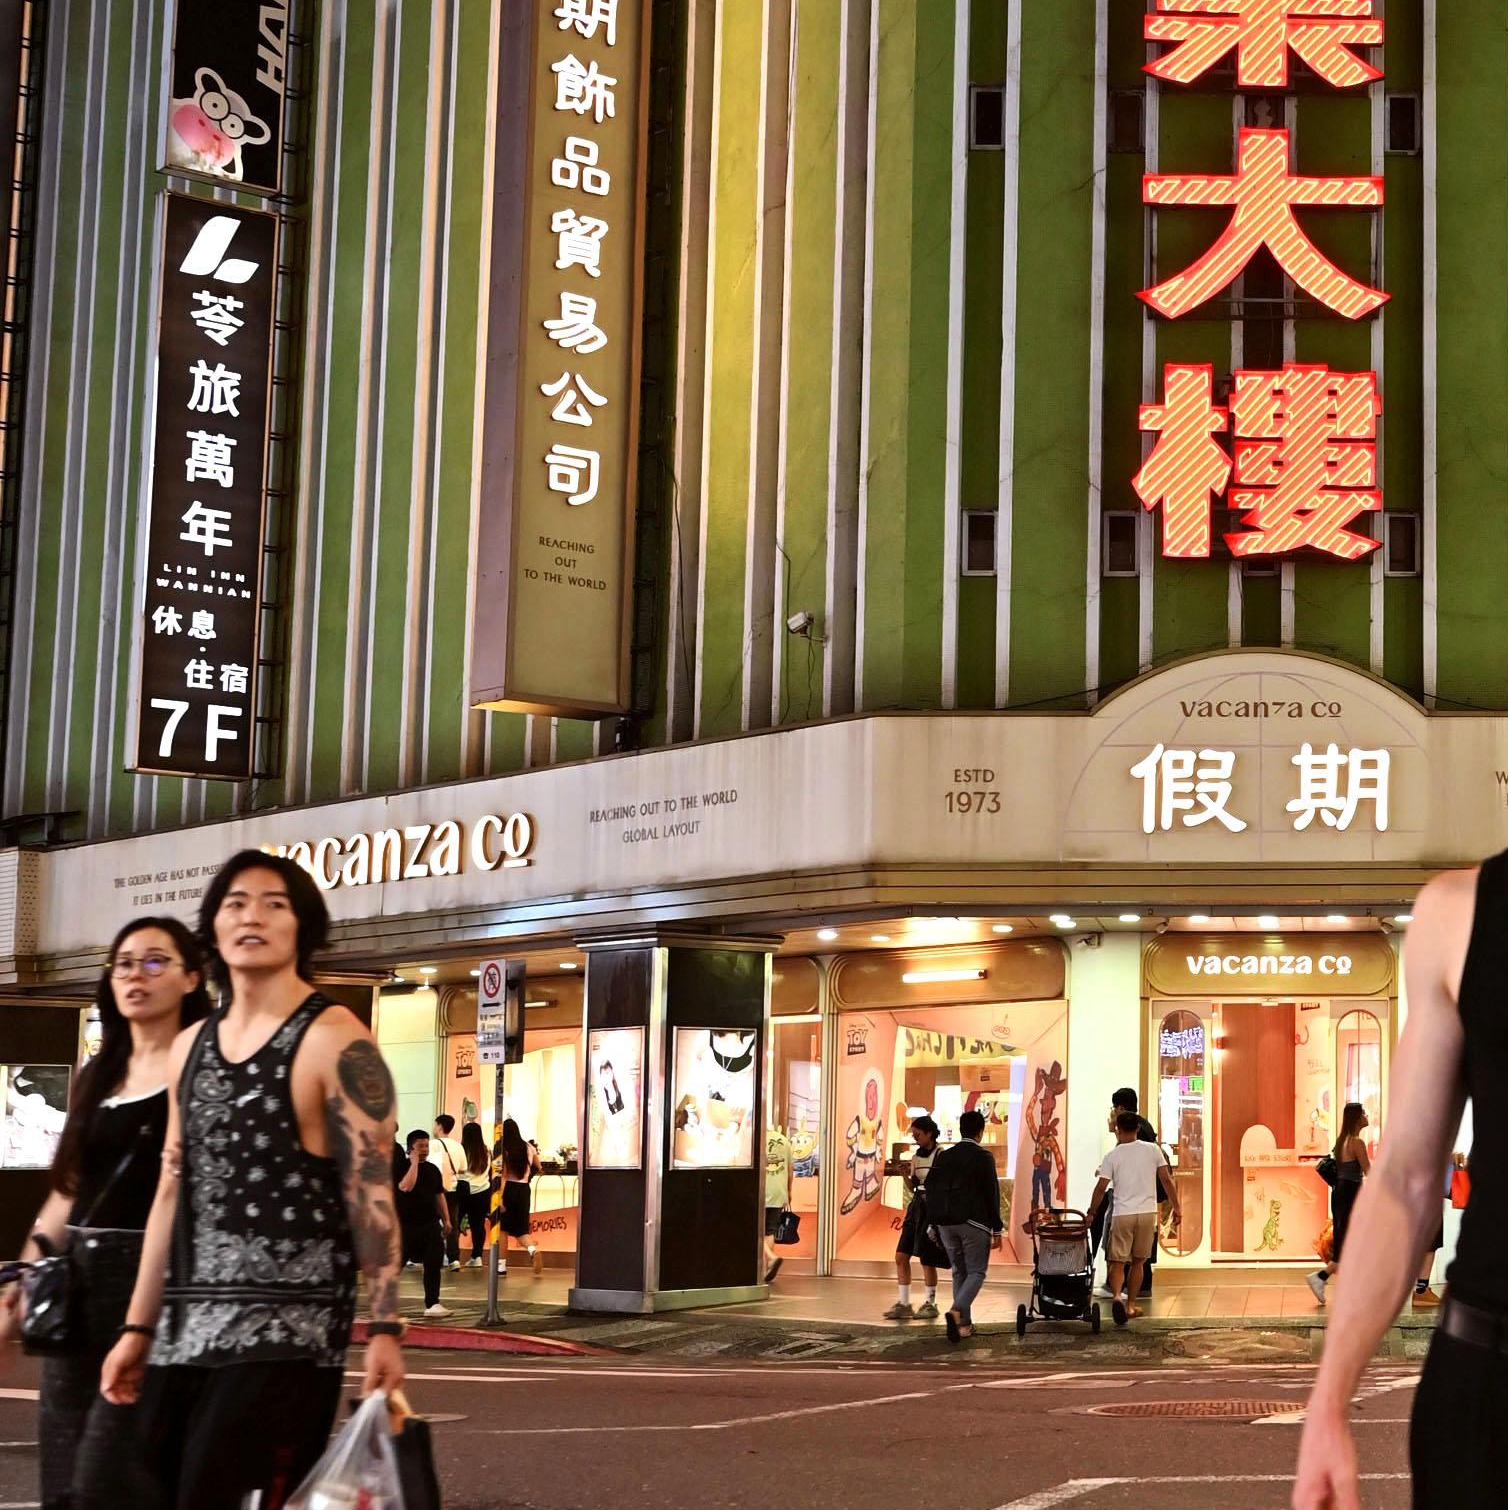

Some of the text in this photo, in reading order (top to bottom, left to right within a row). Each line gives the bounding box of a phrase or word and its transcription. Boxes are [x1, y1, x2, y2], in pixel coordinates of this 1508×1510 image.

[179, 289, 245, 557] 苓旅萬年
[539, 535, 595, 554] REACHING
[163, 563, 245, 583] LIN INN
[554, 556, 577, 569] OUT
[156, 577, 251, 599] WANNIAN
[524, 568, 607, 591] TO THE WORLD
[151, 604, 217, 640] 休息
[184, 658, 249, 695] 住宿
[1180, 698, 1303, 719] vacanza
[150, 697, 243, 764] 7F
[953, 768, 996, 784] ESTD
[1130, 742, 1392, 834] 假期
[589, 789, 738, 823] REACHING OUT TO THE WORLD
[944, 790, 1002, 814] 1973
[622, 820, 701, 844] GLOBAL LAYOUT
[154, 871, 169, 884] AGE
[186, 866, 200, 879] NOT
[1186, 955, 1312, 975] vacanza
